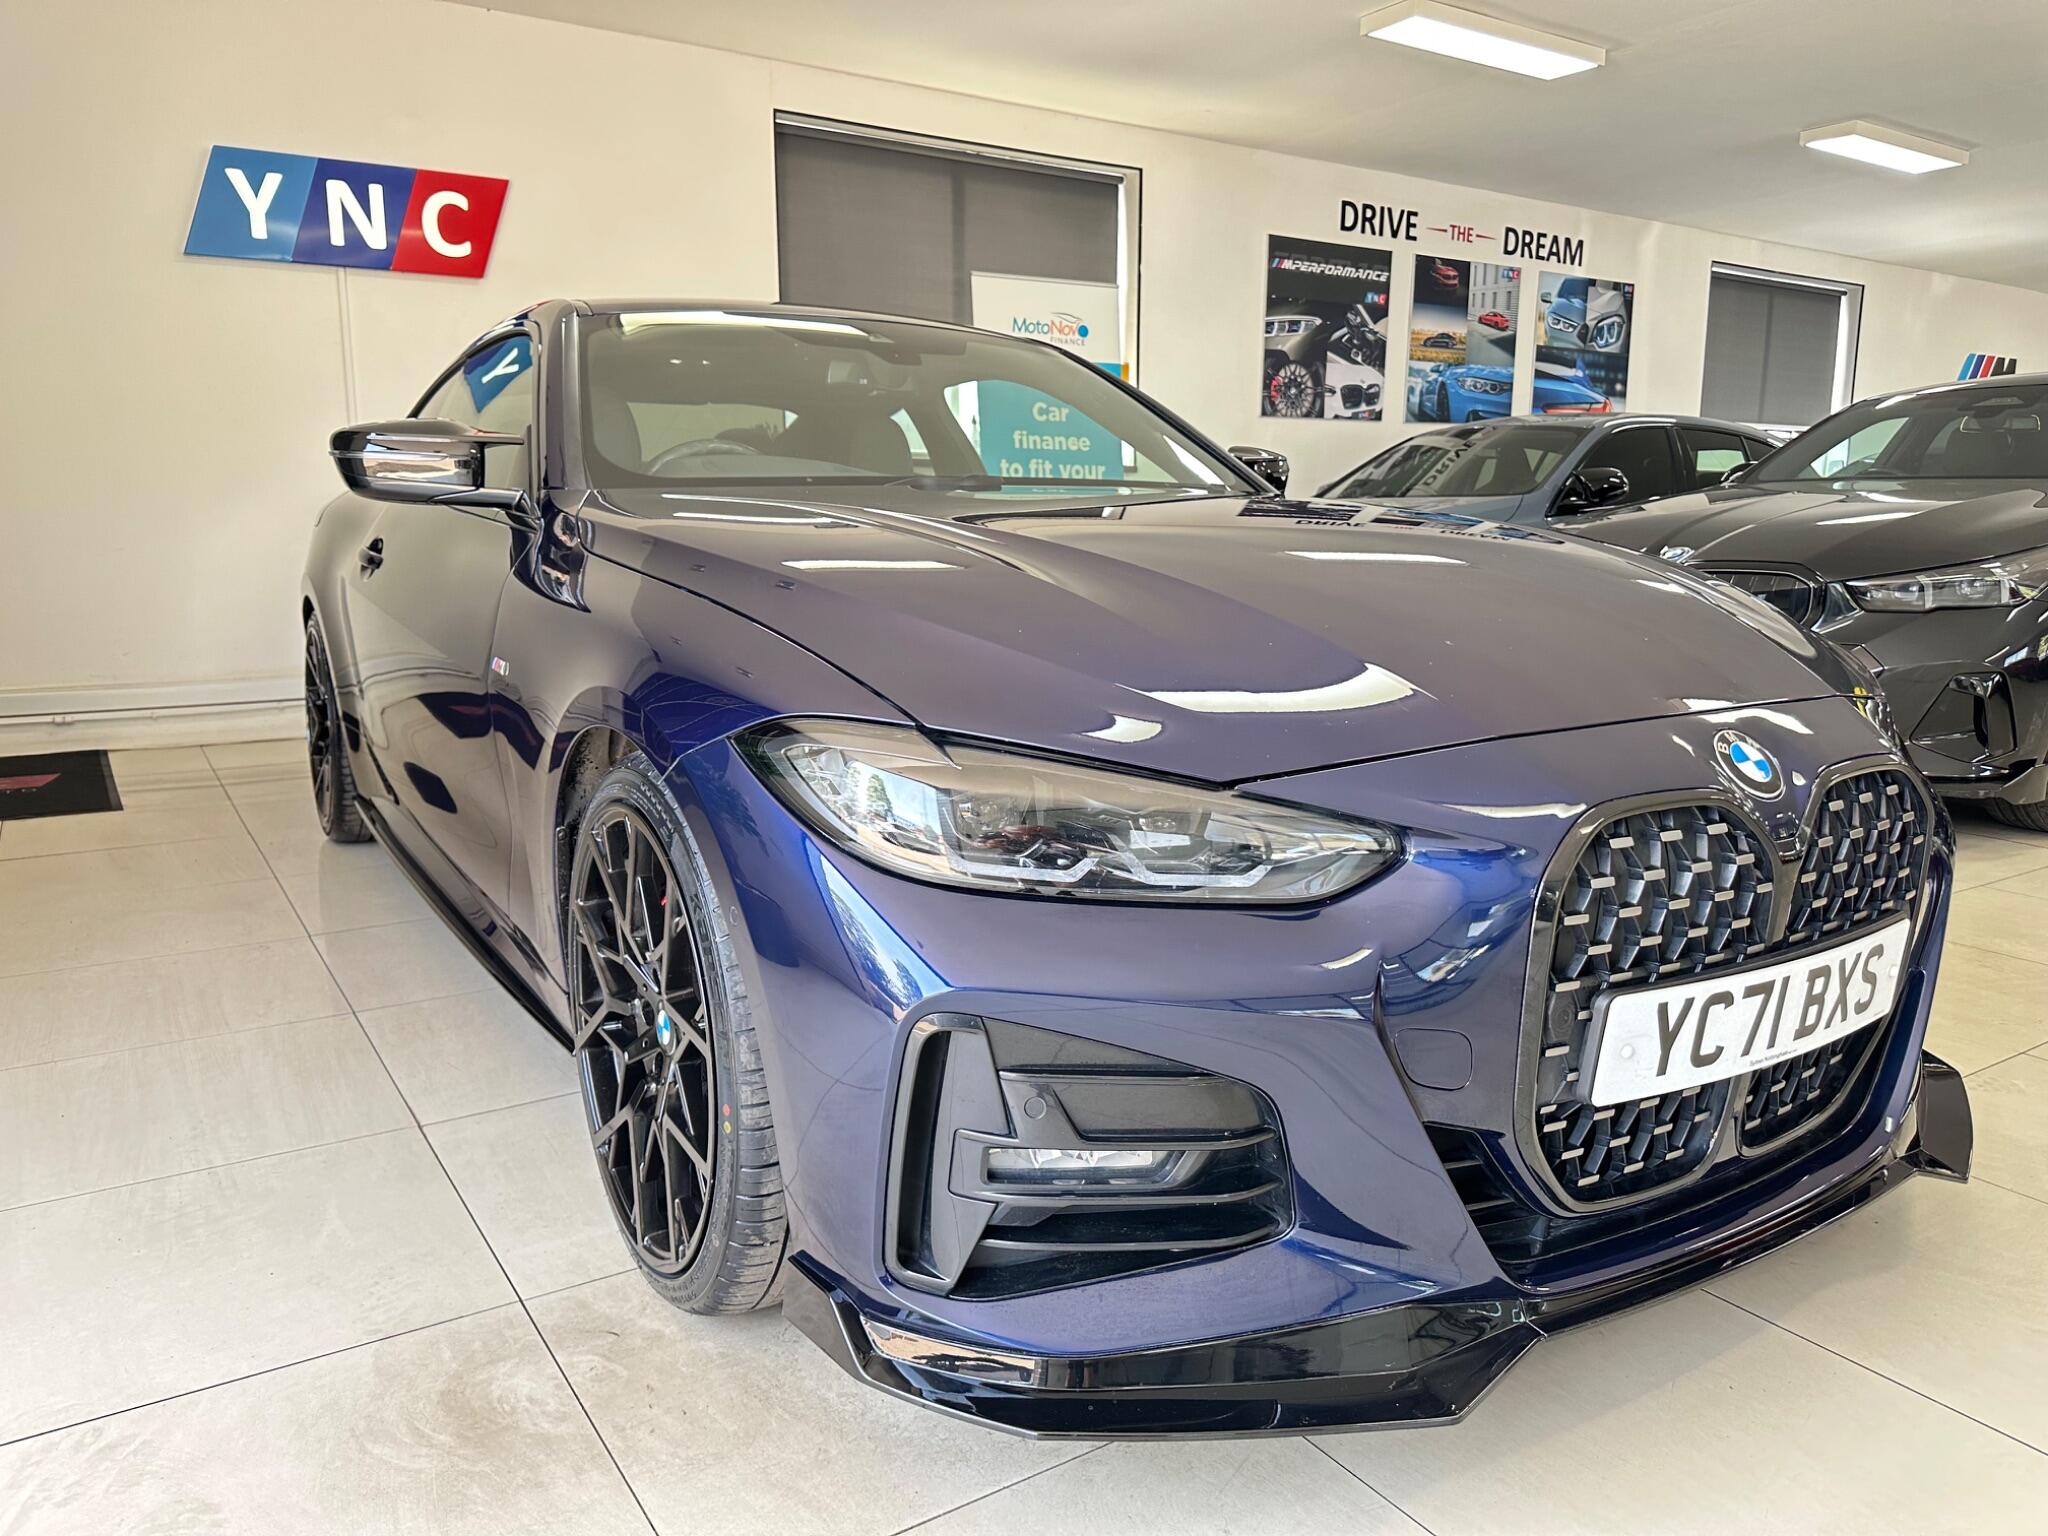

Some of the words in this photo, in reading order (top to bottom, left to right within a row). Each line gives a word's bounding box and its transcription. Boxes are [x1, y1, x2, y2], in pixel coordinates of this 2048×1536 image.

[225, 167, 472, 258] YNC
[1340, 199, 1418, 241] DRIVE
[1450, 224, 1474, 243] THE
[1503, 226, 1584, 267] DREAM
[1012, 316, 1089, 338] MotoNovo
[1050, 336, 1085, 346] FINANCE
[1032, 402, 1070, 422] Car
[1013, 431, 1091, 451] finance
[1000, 459, 1023, 477] to
[1028, 459, 1053, 477] fit
[1059, 464, 1106, 479] your
[1656, 975, 1790, 1078] YC71
[1792, 943, 1884, 1042] BXS
